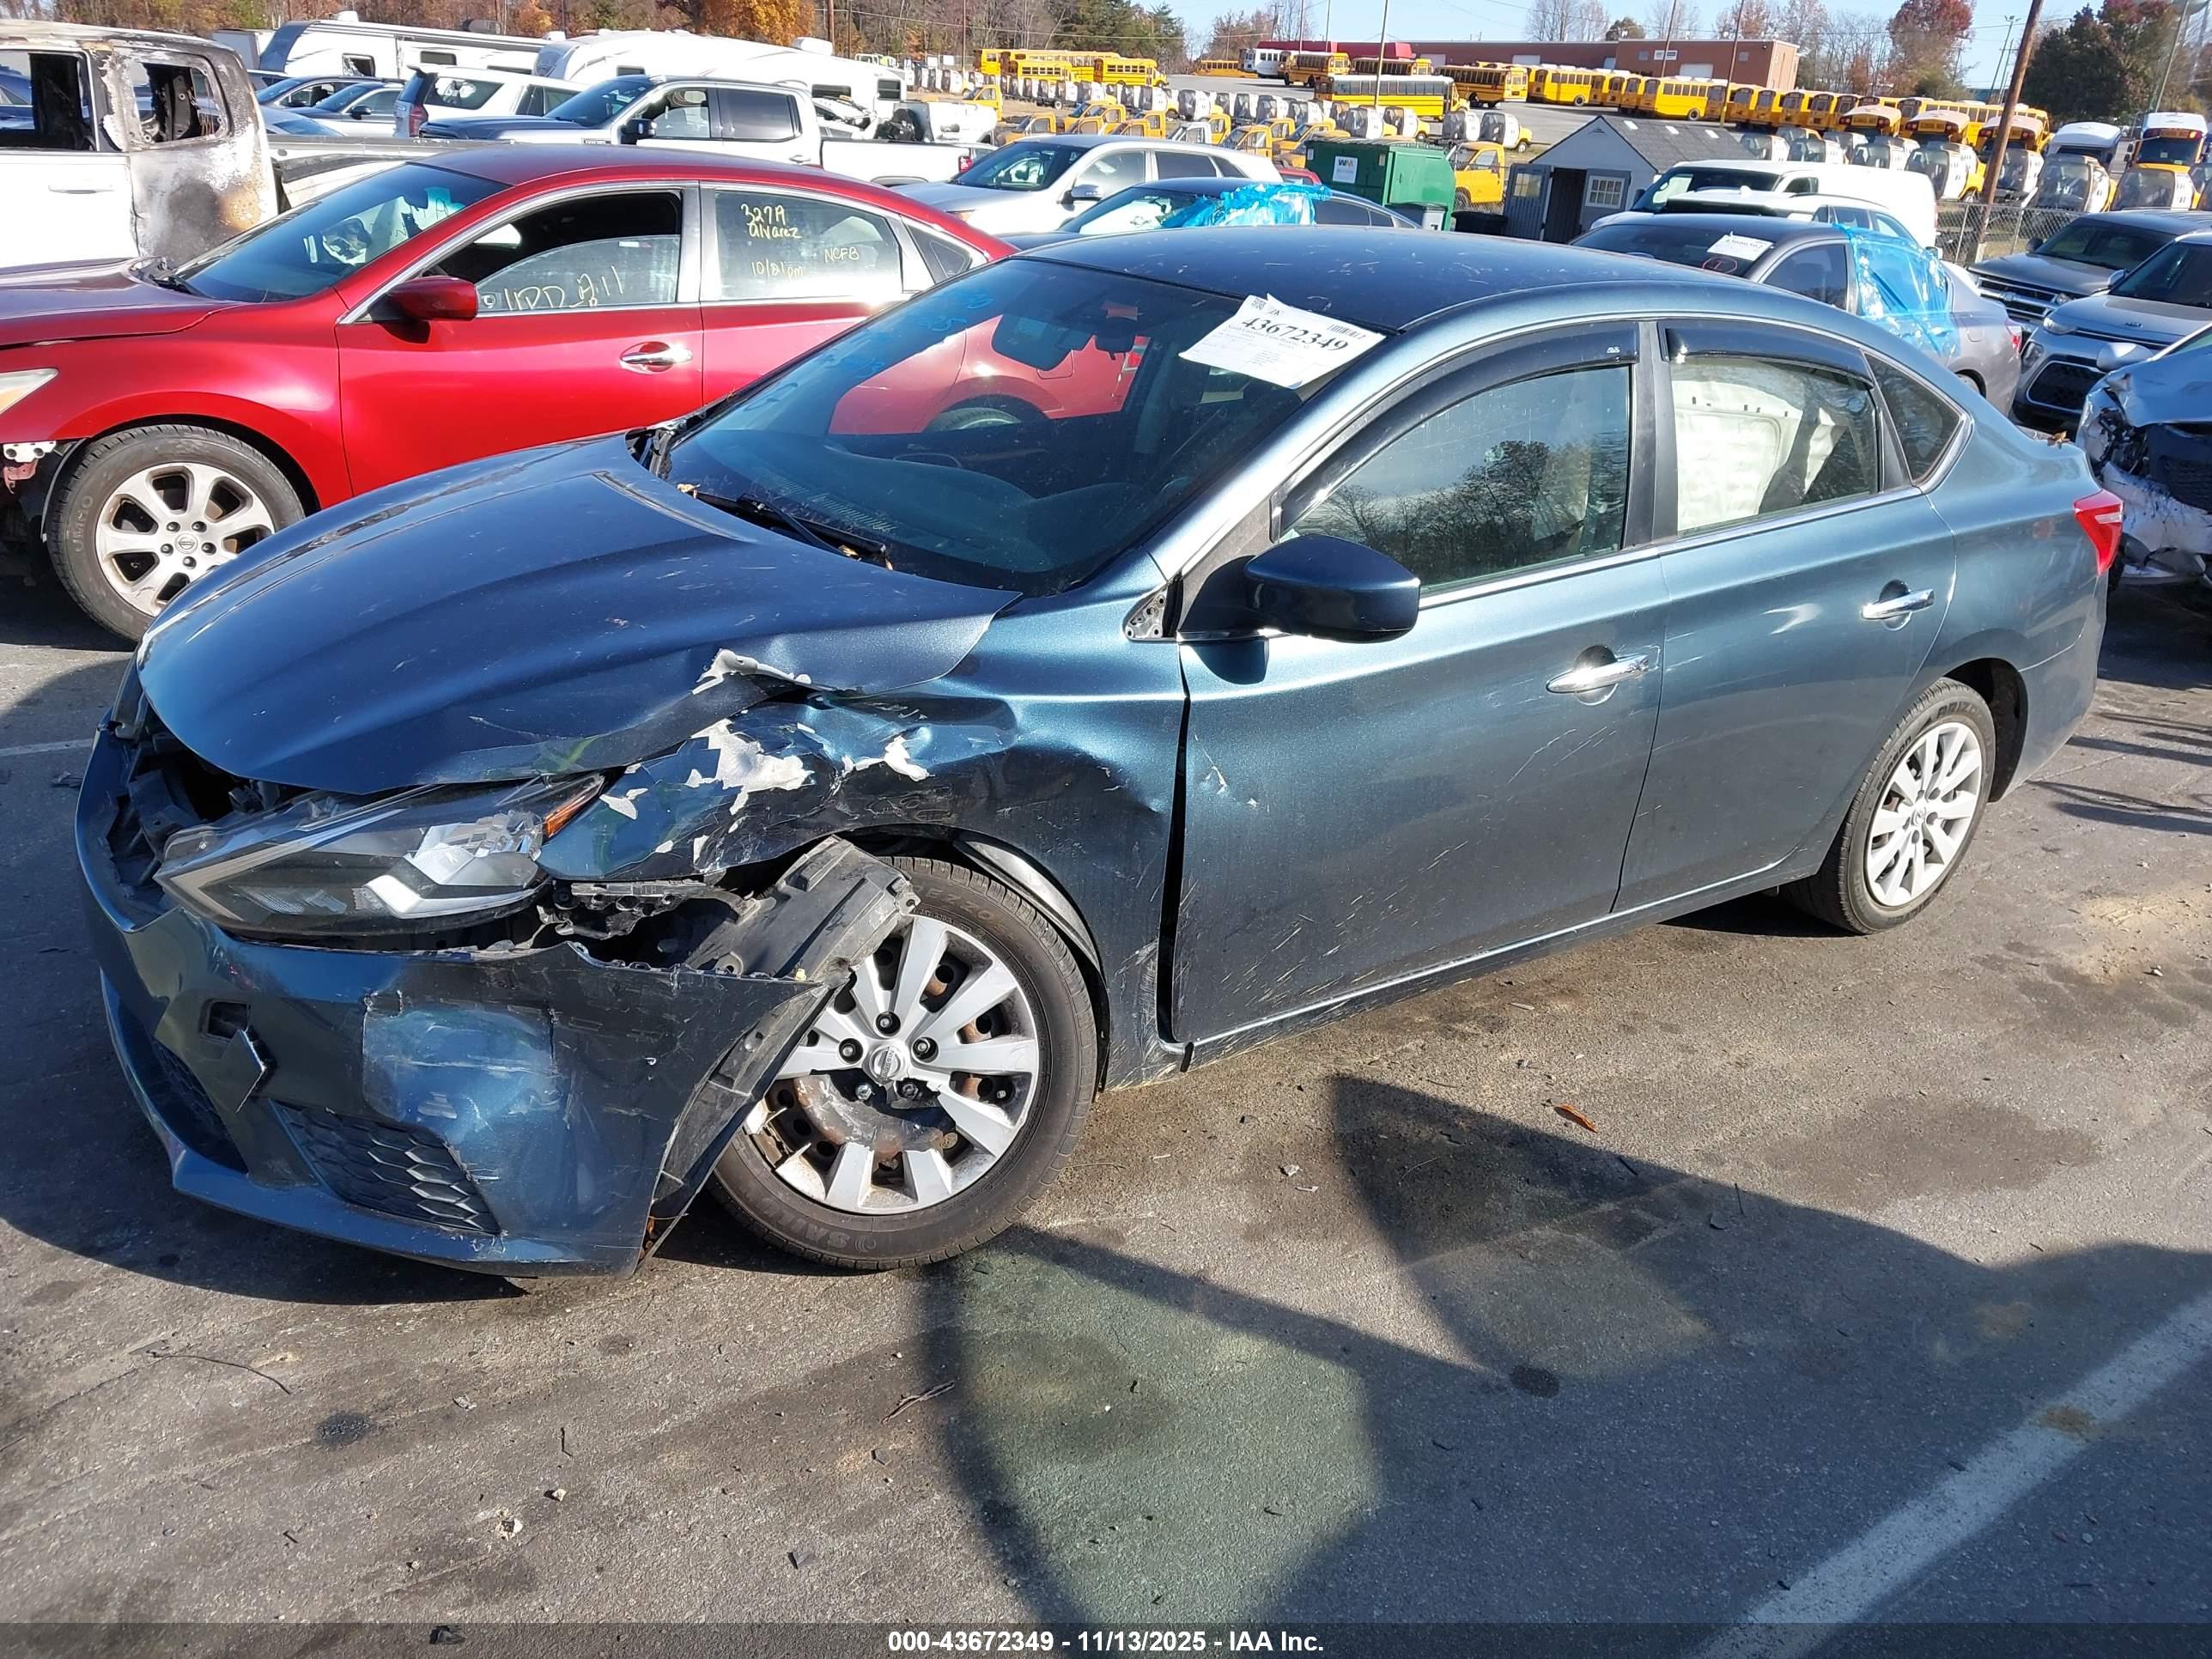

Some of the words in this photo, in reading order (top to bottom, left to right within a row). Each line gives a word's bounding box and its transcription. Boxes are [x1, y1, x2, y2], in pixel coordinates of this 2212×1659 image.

[1338, 159, 1353, 167] WM
[824, 246, 860, 263] NCFB
[1242, 317, 1349, 352] 43672349
